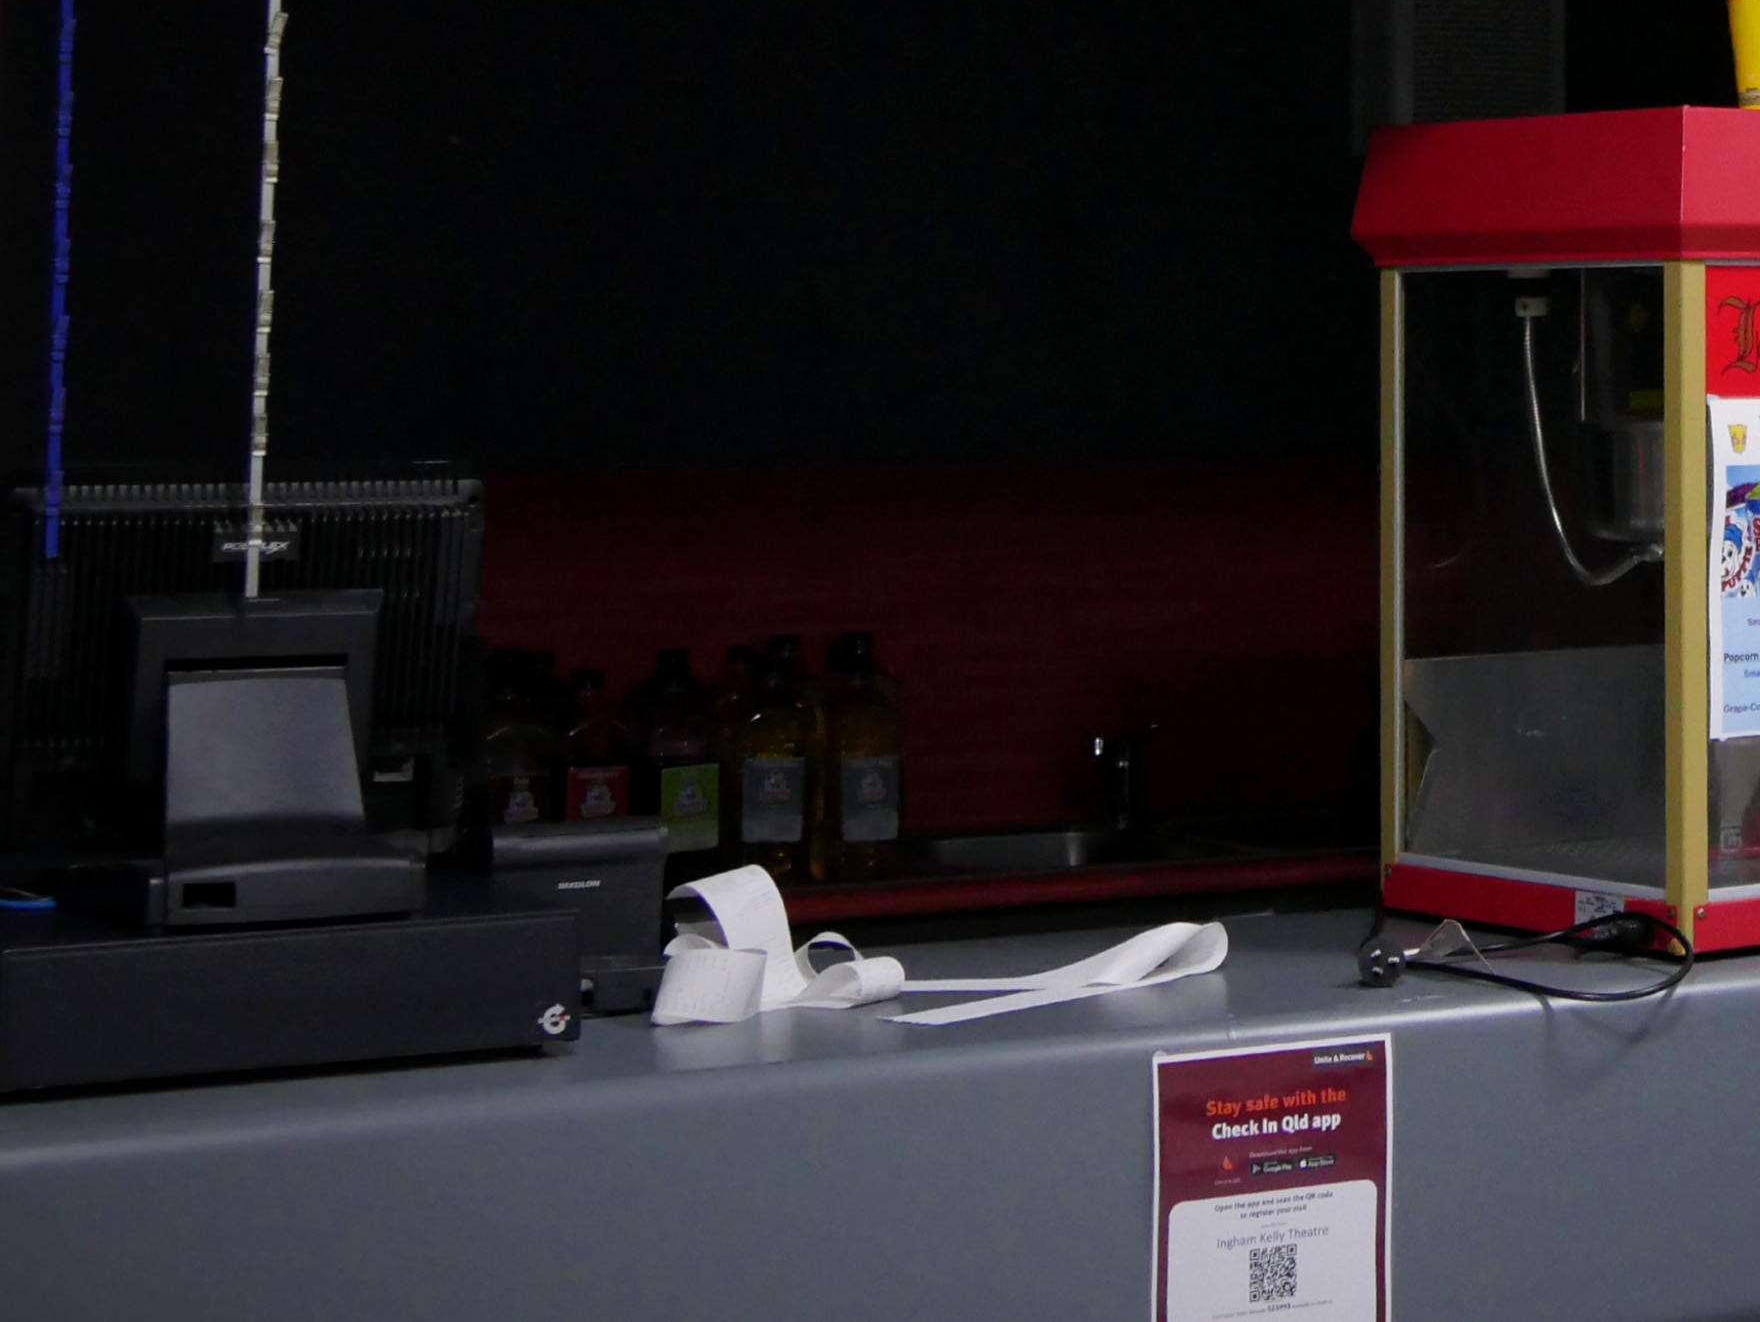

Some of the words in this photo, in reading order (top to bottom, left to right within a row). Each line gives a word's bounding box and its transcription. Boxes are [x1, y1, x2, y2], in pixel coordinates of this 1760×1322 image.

[1723, 652, 1759, 663] Popcorn
[1314, 1055, 1332, 1065] Unite
[1340, 1053, 1365, 1062] Recover
[1206, 1099, 1241, 1117] Stay
[1246, 1095, 1278, 1111] safe
[1283, 1090, 1316, 1107] with
[1321, 1088, 1346, 1103] the
[1212, 1120, 1259, 1140] Check
[1262, 1117, 1278, 1134] In
[1282, 1113, 1309, 1133] Qld
[1312, 1113, 1341, 1131] app
[1234, 1201, 1246, 1209] the
[1262, 1198, 1274, 1206] and
[1317, 1190, 1333, 1198] code
[1277, 1207, 1291, 1215] your
[1217, 1236, 1256, 1250] Ingham
[1260, 1230, 1285, 1243] Kelly
[1288, 1226, 1329, 1239] Theatre
